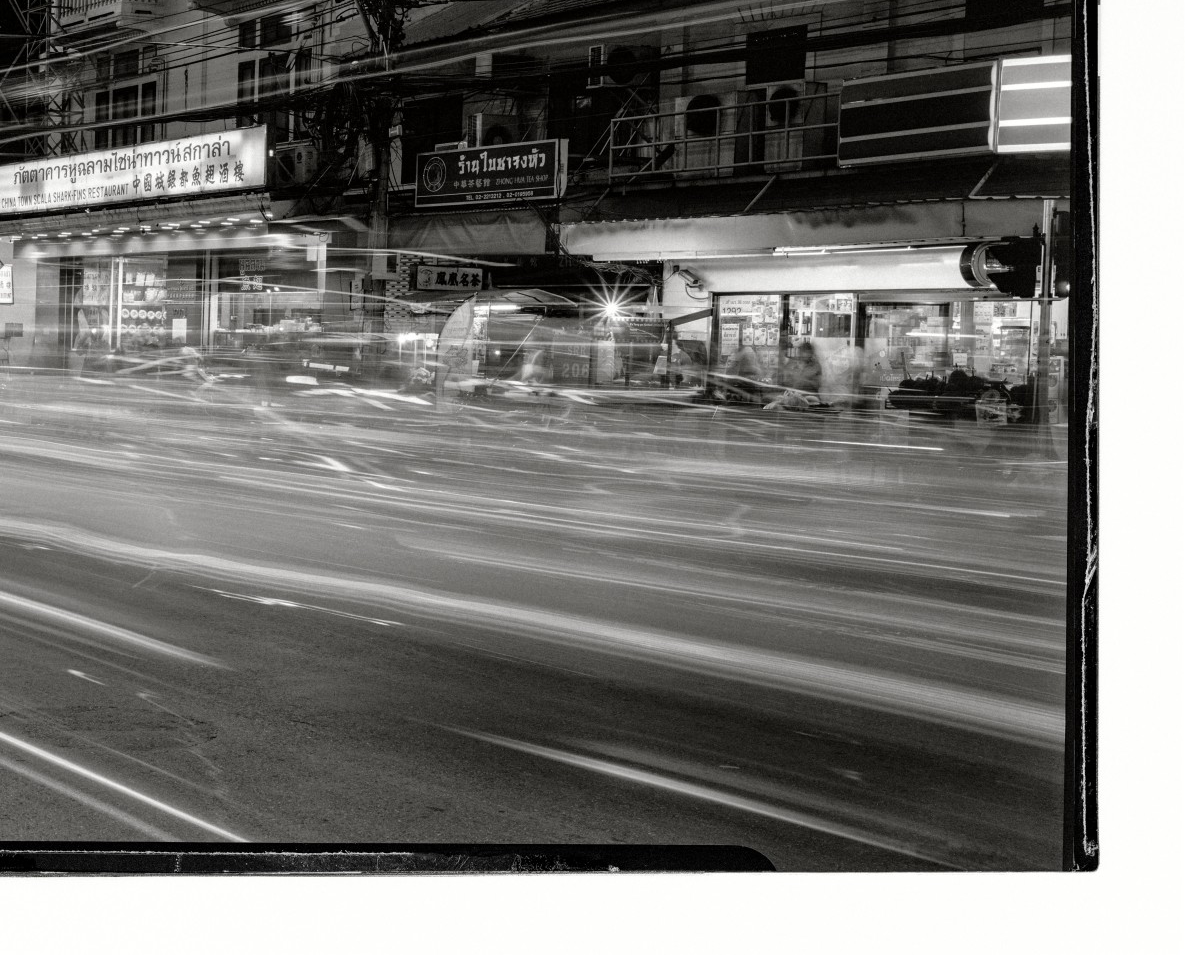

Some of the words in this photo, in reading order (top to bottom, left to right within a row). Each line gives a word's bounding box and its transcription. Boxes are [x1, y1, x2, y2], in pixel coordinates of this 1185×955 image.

[495, 177, 514, 186] ZHONG
[526, 175, 535, 183] TEA
[535, 174, 549, 183] SHOP
[1, 197, 17, 208] CHINA
[17, 195, 33, 207] TOWN
[33, 193, 52, 205] SCALA
[88, 183, 129, 199] RESTAURANT
